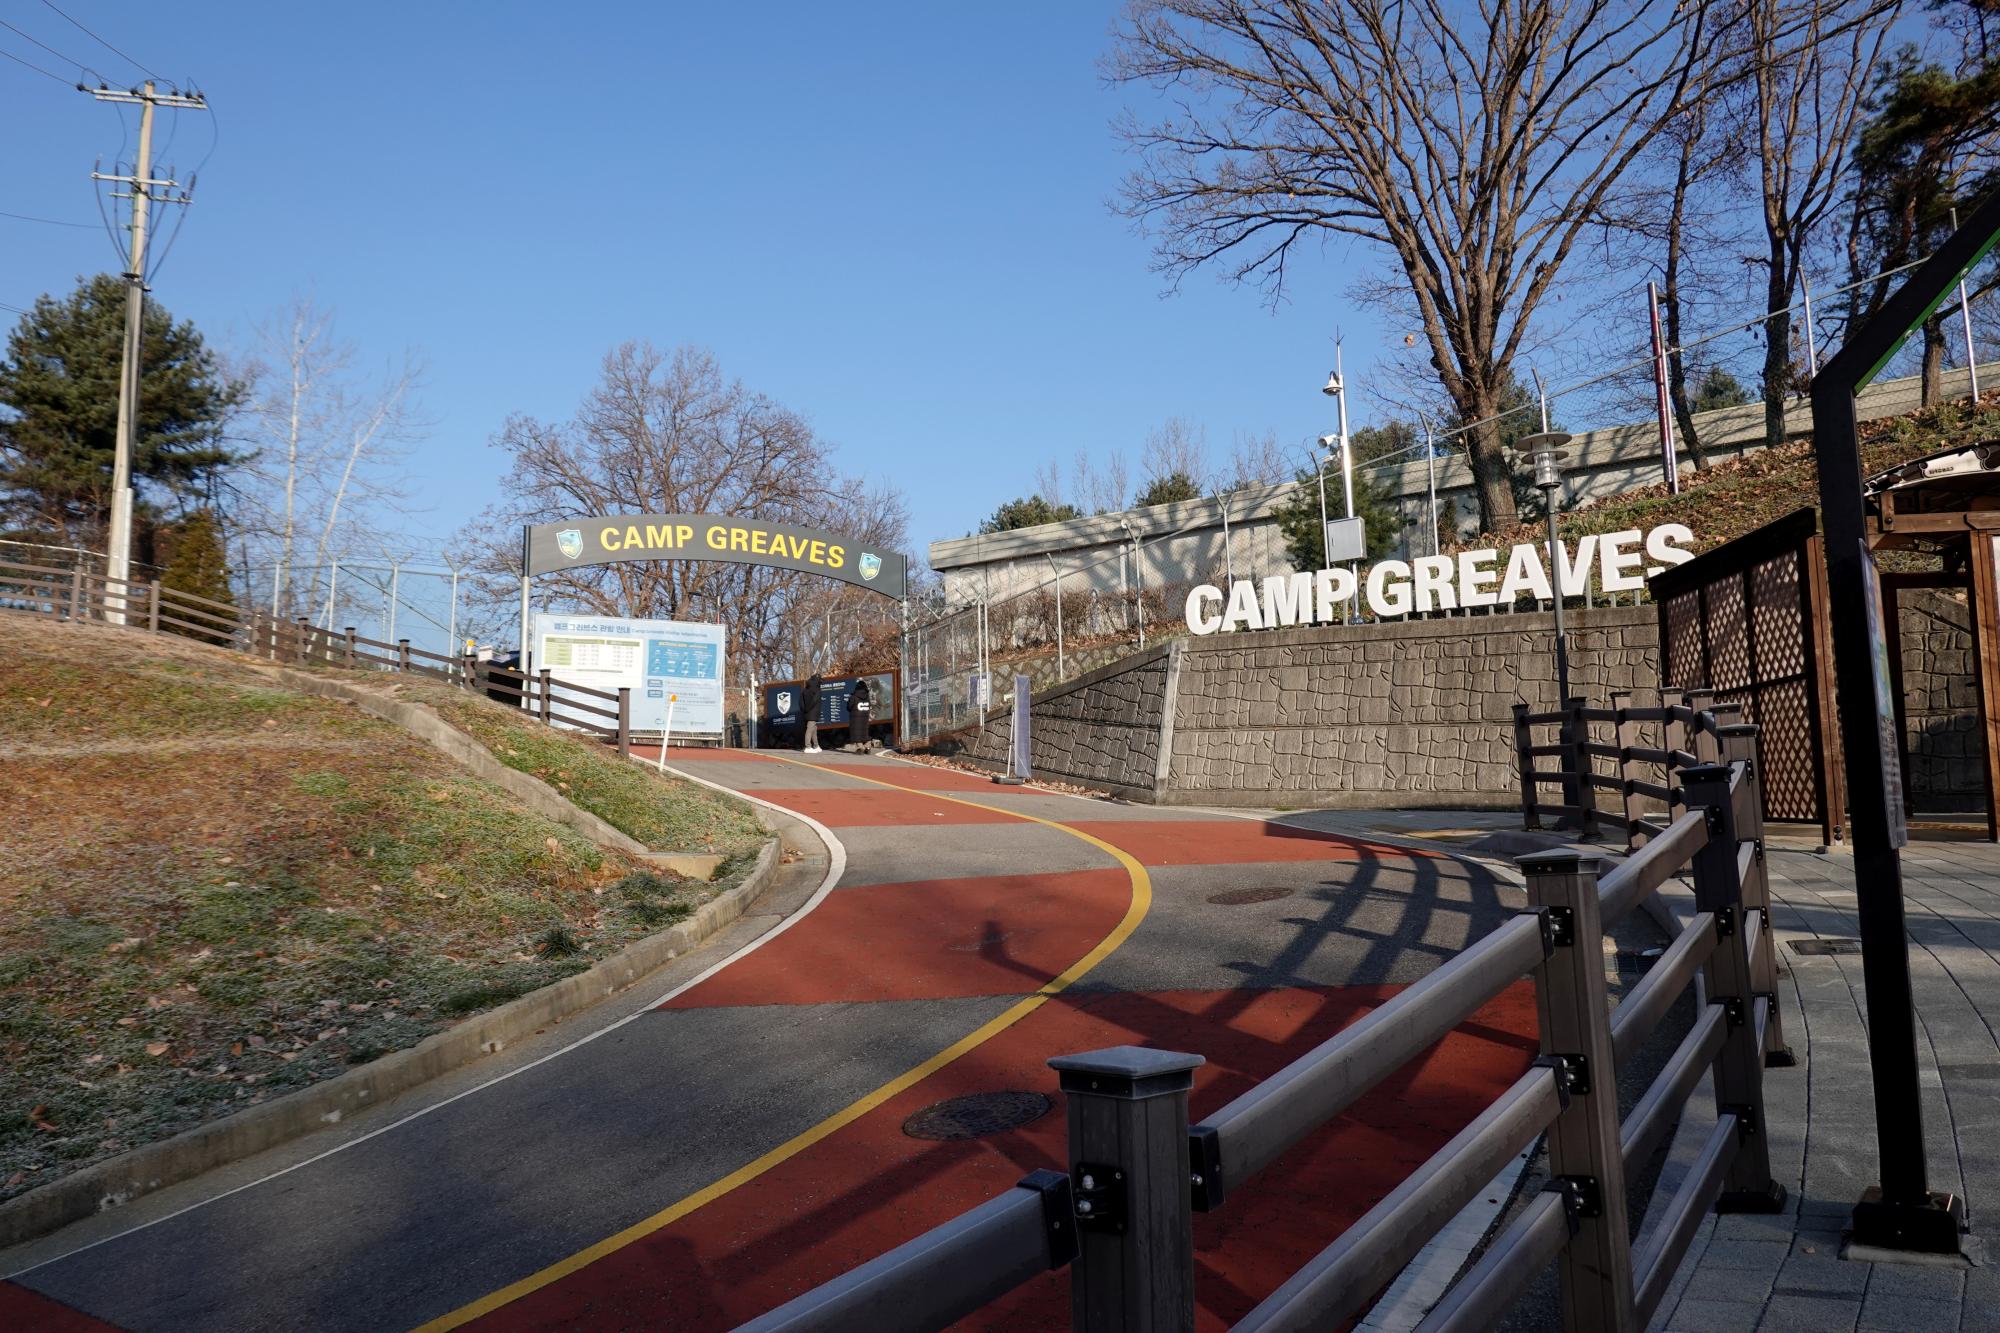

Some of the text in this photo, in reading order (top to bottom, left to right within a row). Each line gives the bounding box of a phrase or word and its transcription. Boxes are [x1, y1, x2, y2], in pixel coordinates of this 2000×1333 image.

[600, 525, 846, 568] CAMP GREAVES
[1185, 523, 1696, 635] CAMP GREAVES
